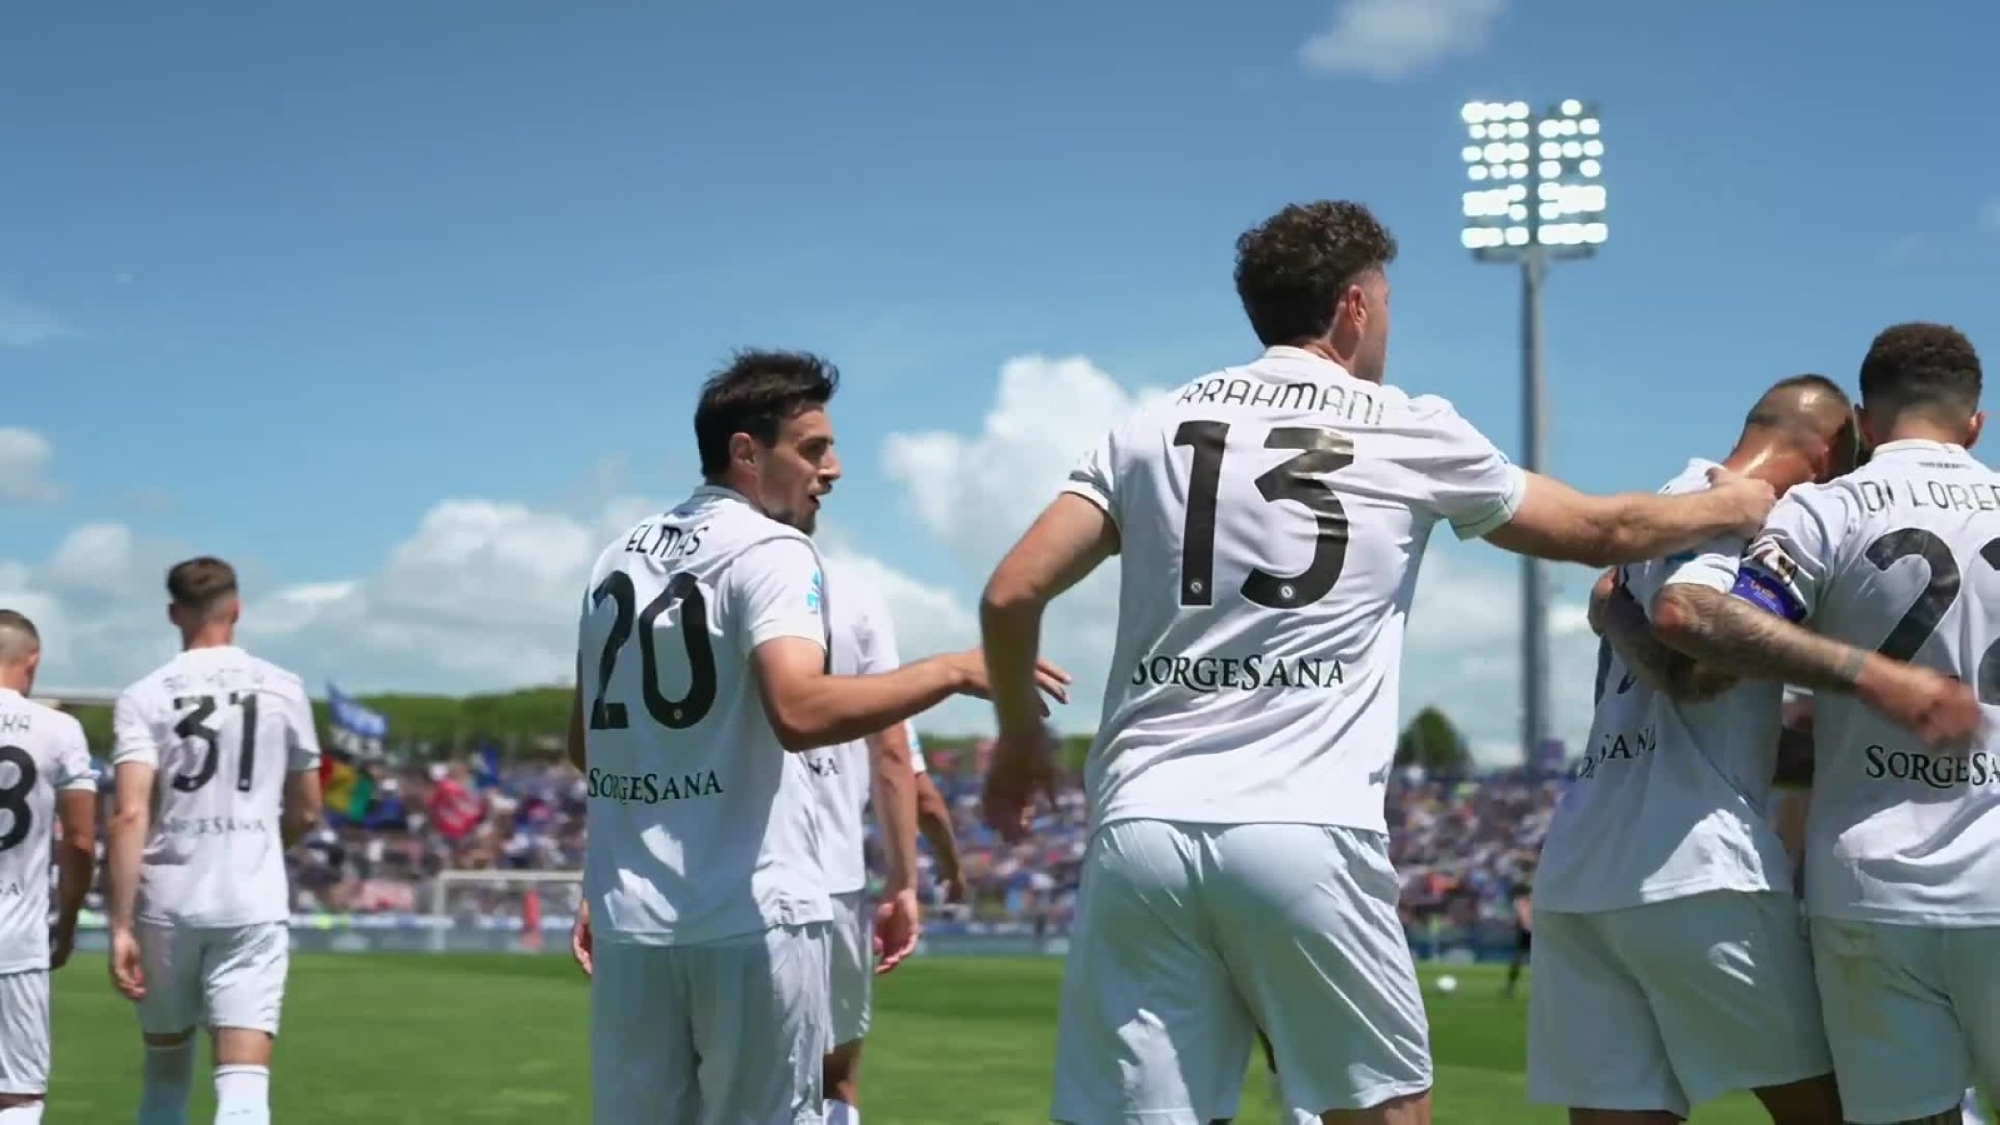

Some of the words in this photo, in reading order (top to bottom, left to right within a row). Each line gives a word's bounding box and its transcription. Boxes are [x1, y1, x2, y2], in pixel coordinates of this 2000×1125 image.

[1176, 377, 1385, 426] RRAHMANI
[1172, 418, 1356, 610] 13
[1858, 479, 1895, 514] DI
[624, 524, 709, 558] ELMAS
[590, 569, 717, 731] 20
[1864, 527, 2000, 707] 2
[1132, 654, 1345, 693] SORGESANA
[172, 691, 258, 793] 31
